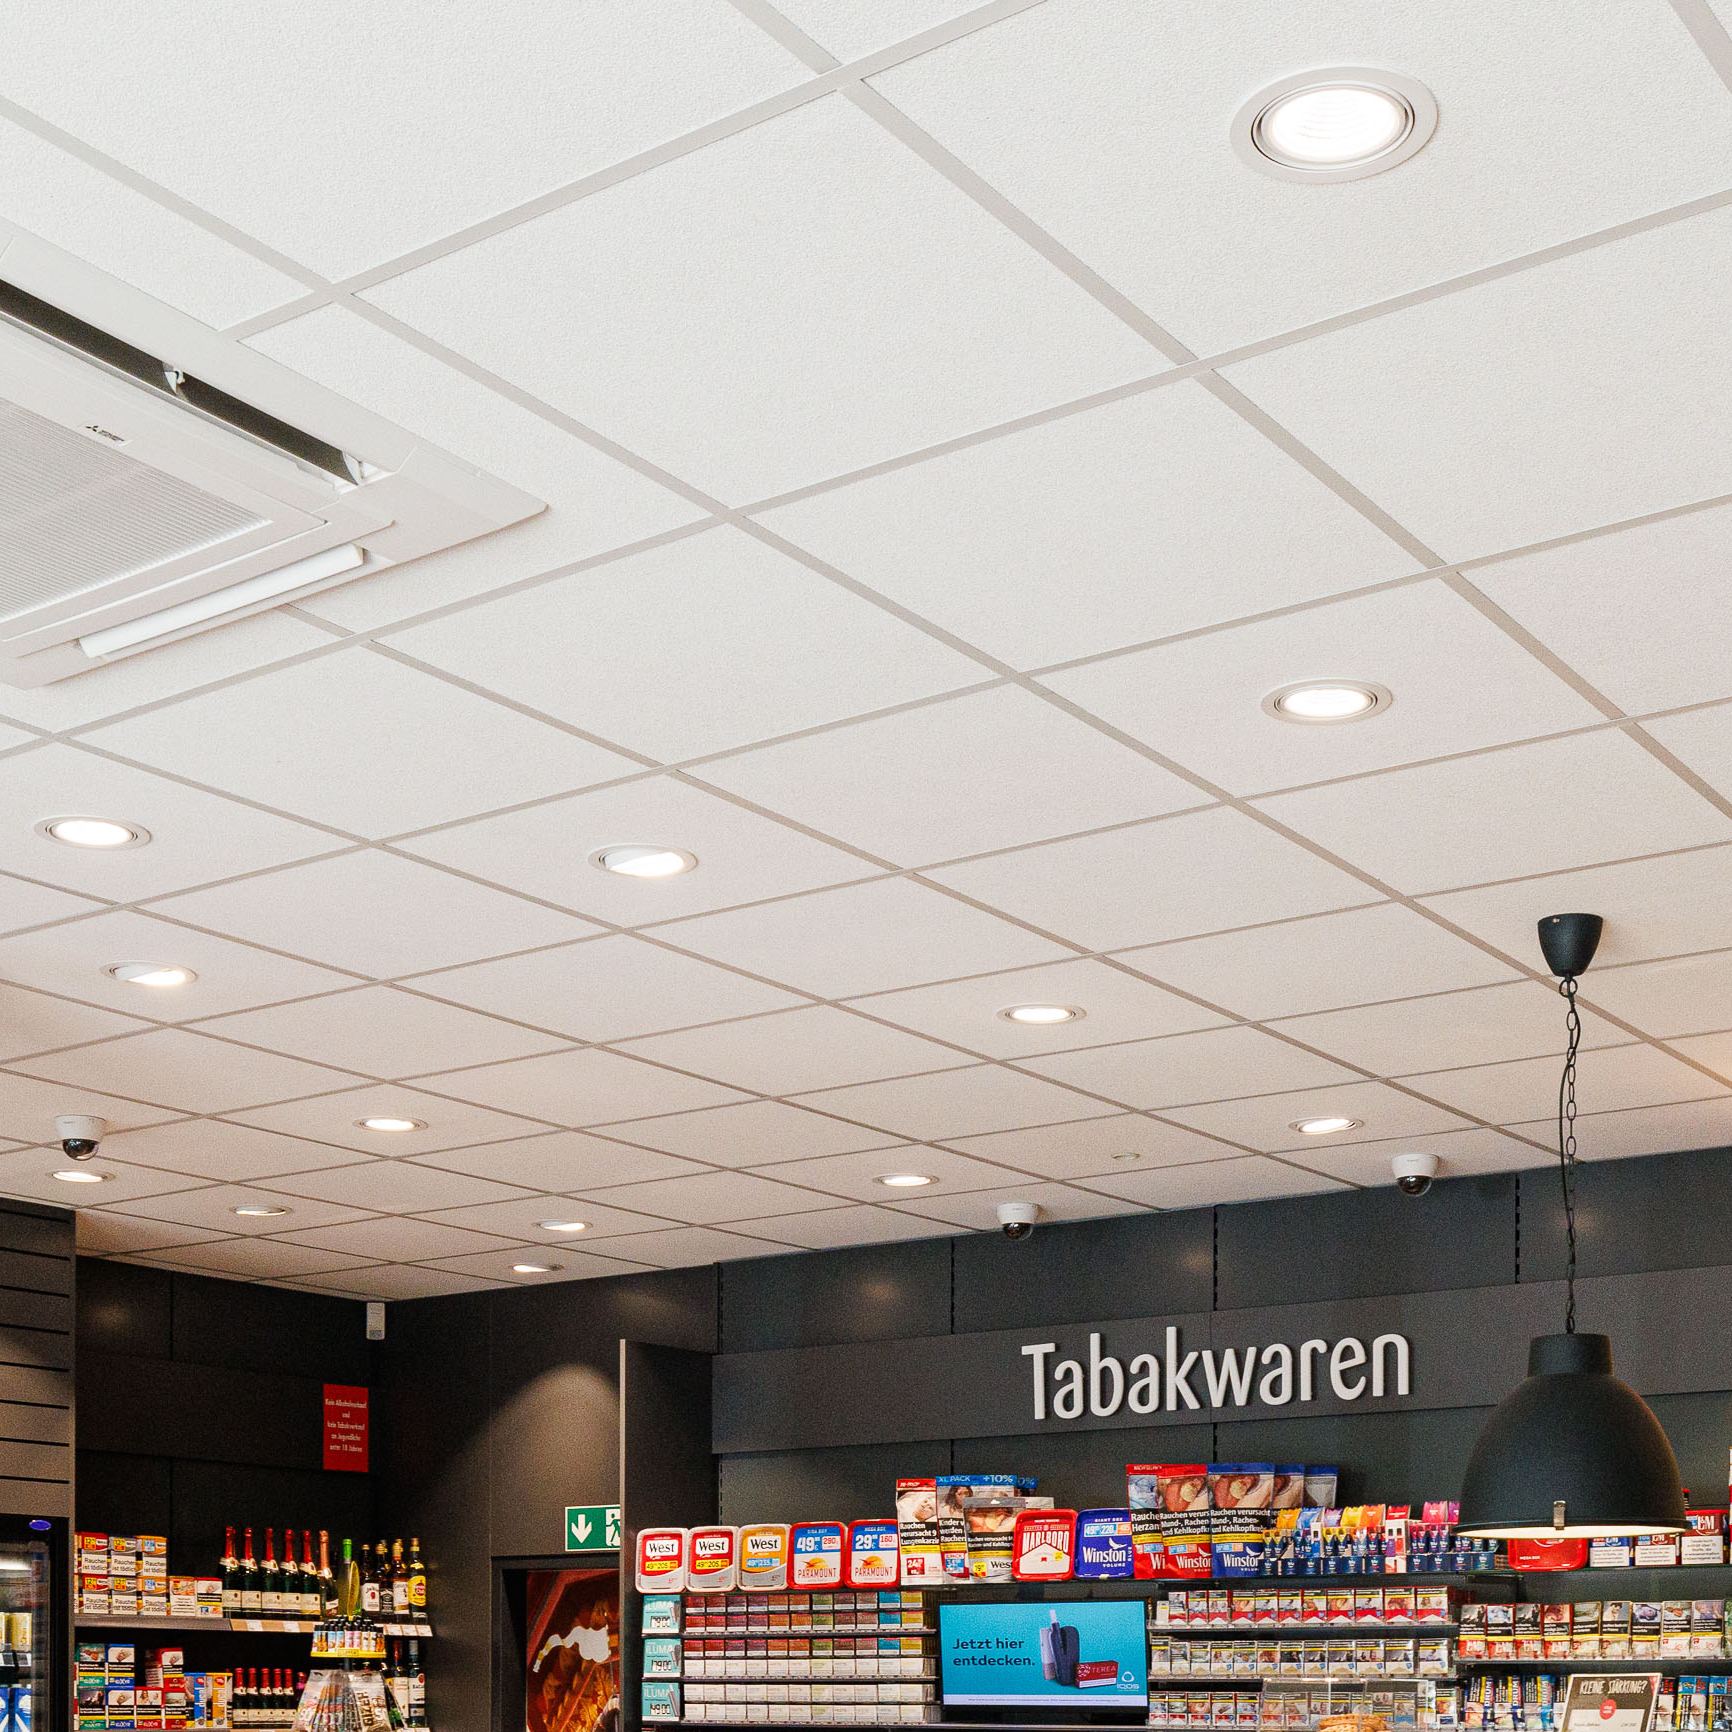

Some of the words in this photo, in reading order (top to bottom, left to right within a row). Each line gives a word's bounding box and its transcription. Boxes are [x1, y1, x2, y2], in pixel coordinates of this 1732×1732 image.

[1021, 1326, 1410, 1420] Tabakwaren
[983, 1475, 1013, 1483] +10%
[1132, 1513, 1159, 1521] Rauche
[900, 1522, 926, 1530] Rauchen
[939, 1519, 959, 1527] Kinder
[648, 1543, 675, 1553] West
[698, 1541, 725, 1551] West
[750, 1538, 778, 1549] West
[1022, 1532, 1069, 1554] MARLBORO
[1082, 1546, 1127, 1563] Winston
[797, 1566, 837, 1579] PARAMOUNT
[854, 1566, 893, 1577] PARAMOUNT
[953, 1638, 992, 1650] Jetzt
[996, 1638, 1024, 1649] hier
[953, 1655, 1036, 1666] entdecken.
[1091, 1665, 1117, 1673] TEREA
[1580, 1680, 1604, 1694] KLEINE
[1607, 1678, 1648, 1695] STÄRKUNG?
